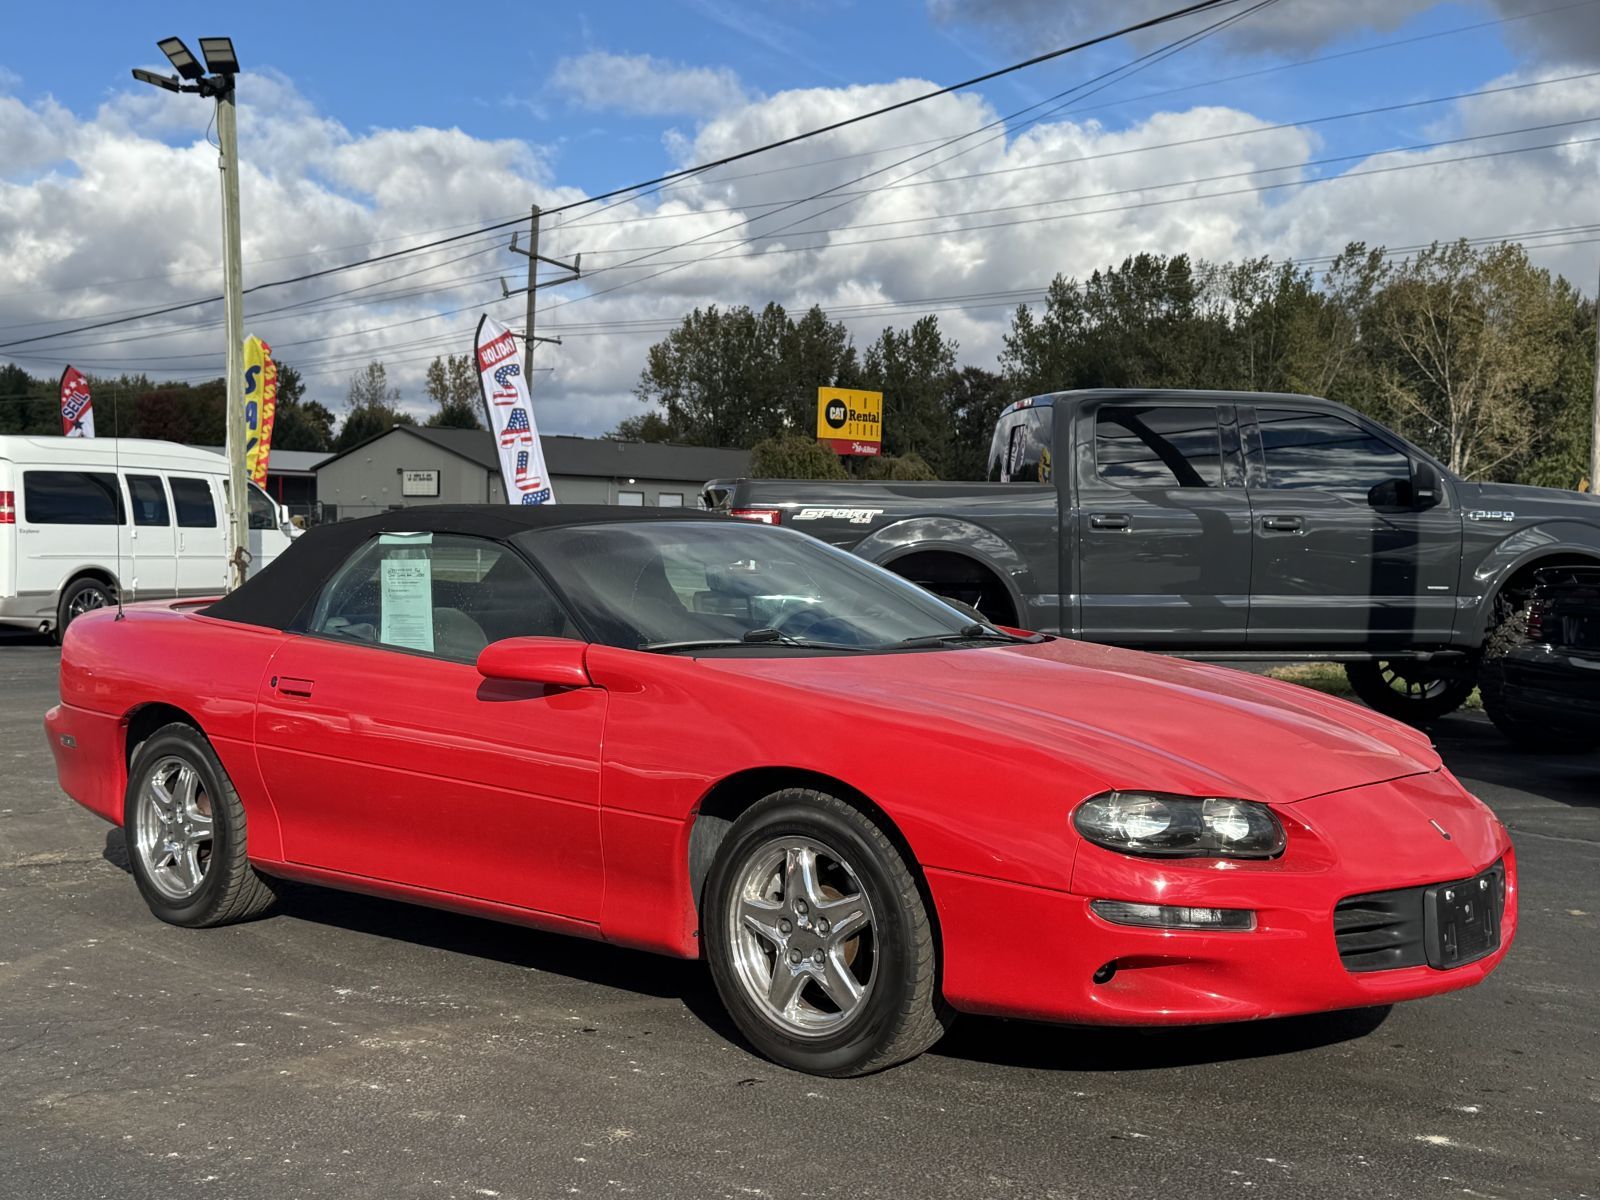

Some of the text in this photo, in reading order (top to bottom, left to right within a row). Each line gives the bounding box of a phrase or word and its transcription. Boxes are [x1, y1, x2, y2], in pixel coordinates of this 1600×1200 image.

[481, 338, 516, 364] HOLIDAY
[62, 391, 90, 420] SELL
[829, 406, 880, 423] CAT Rental
[792, 508, 883, 520] SPORT
